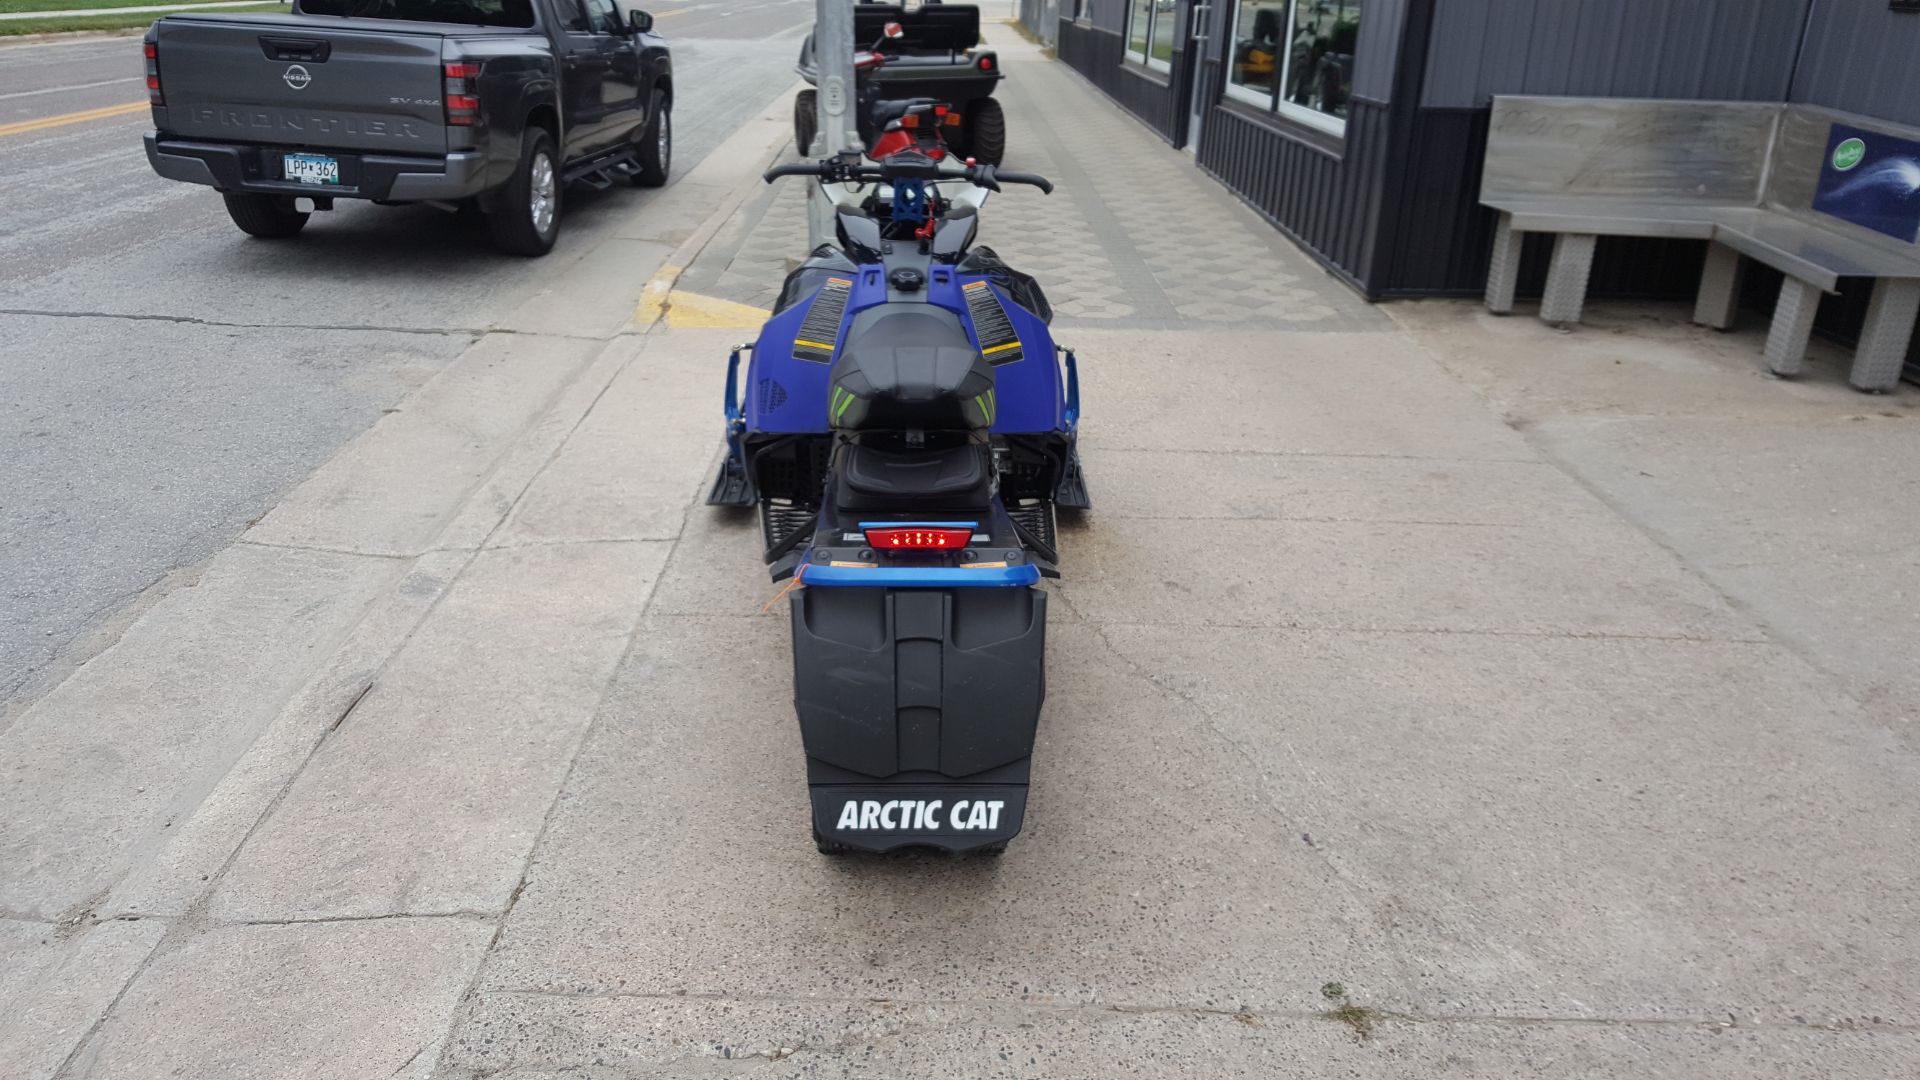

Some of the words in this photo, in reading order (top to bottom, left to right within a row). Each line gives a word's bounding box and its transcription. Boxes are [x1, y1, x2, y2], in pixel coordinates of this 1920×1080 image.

[191, 107, 419, 138] FRONTIER
[836, 800, 942, 830] ARCTIC
[950, 800, 1004, 830] CAT
